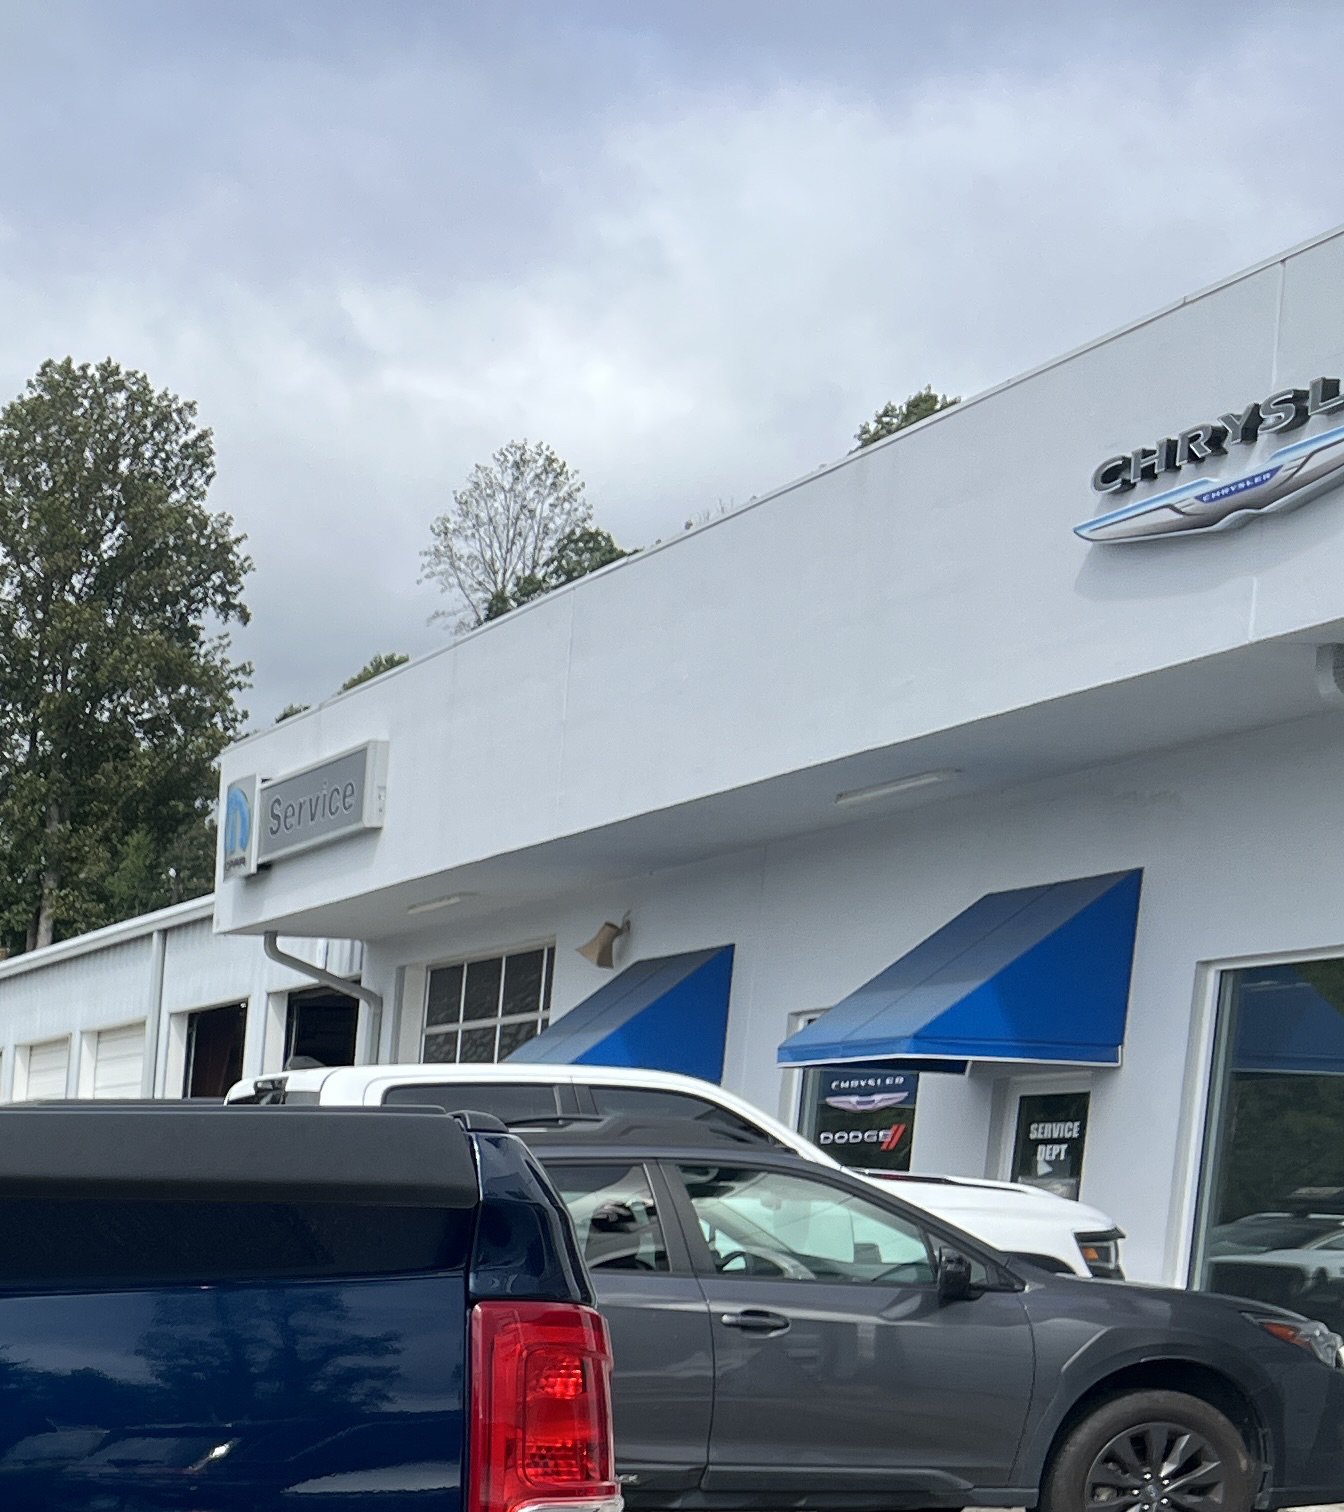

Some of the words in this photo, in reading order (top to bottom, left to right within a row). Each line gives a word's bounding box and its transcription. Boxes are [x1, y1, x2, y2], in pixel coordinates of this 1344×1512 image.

[269, 780, 355, 837] Service
[819, 1129, 893, 1145] DODGE
[1029, 1120, 1080, 1140] SERVICE
[1037, 1143, 1068, 1161] DEPT
